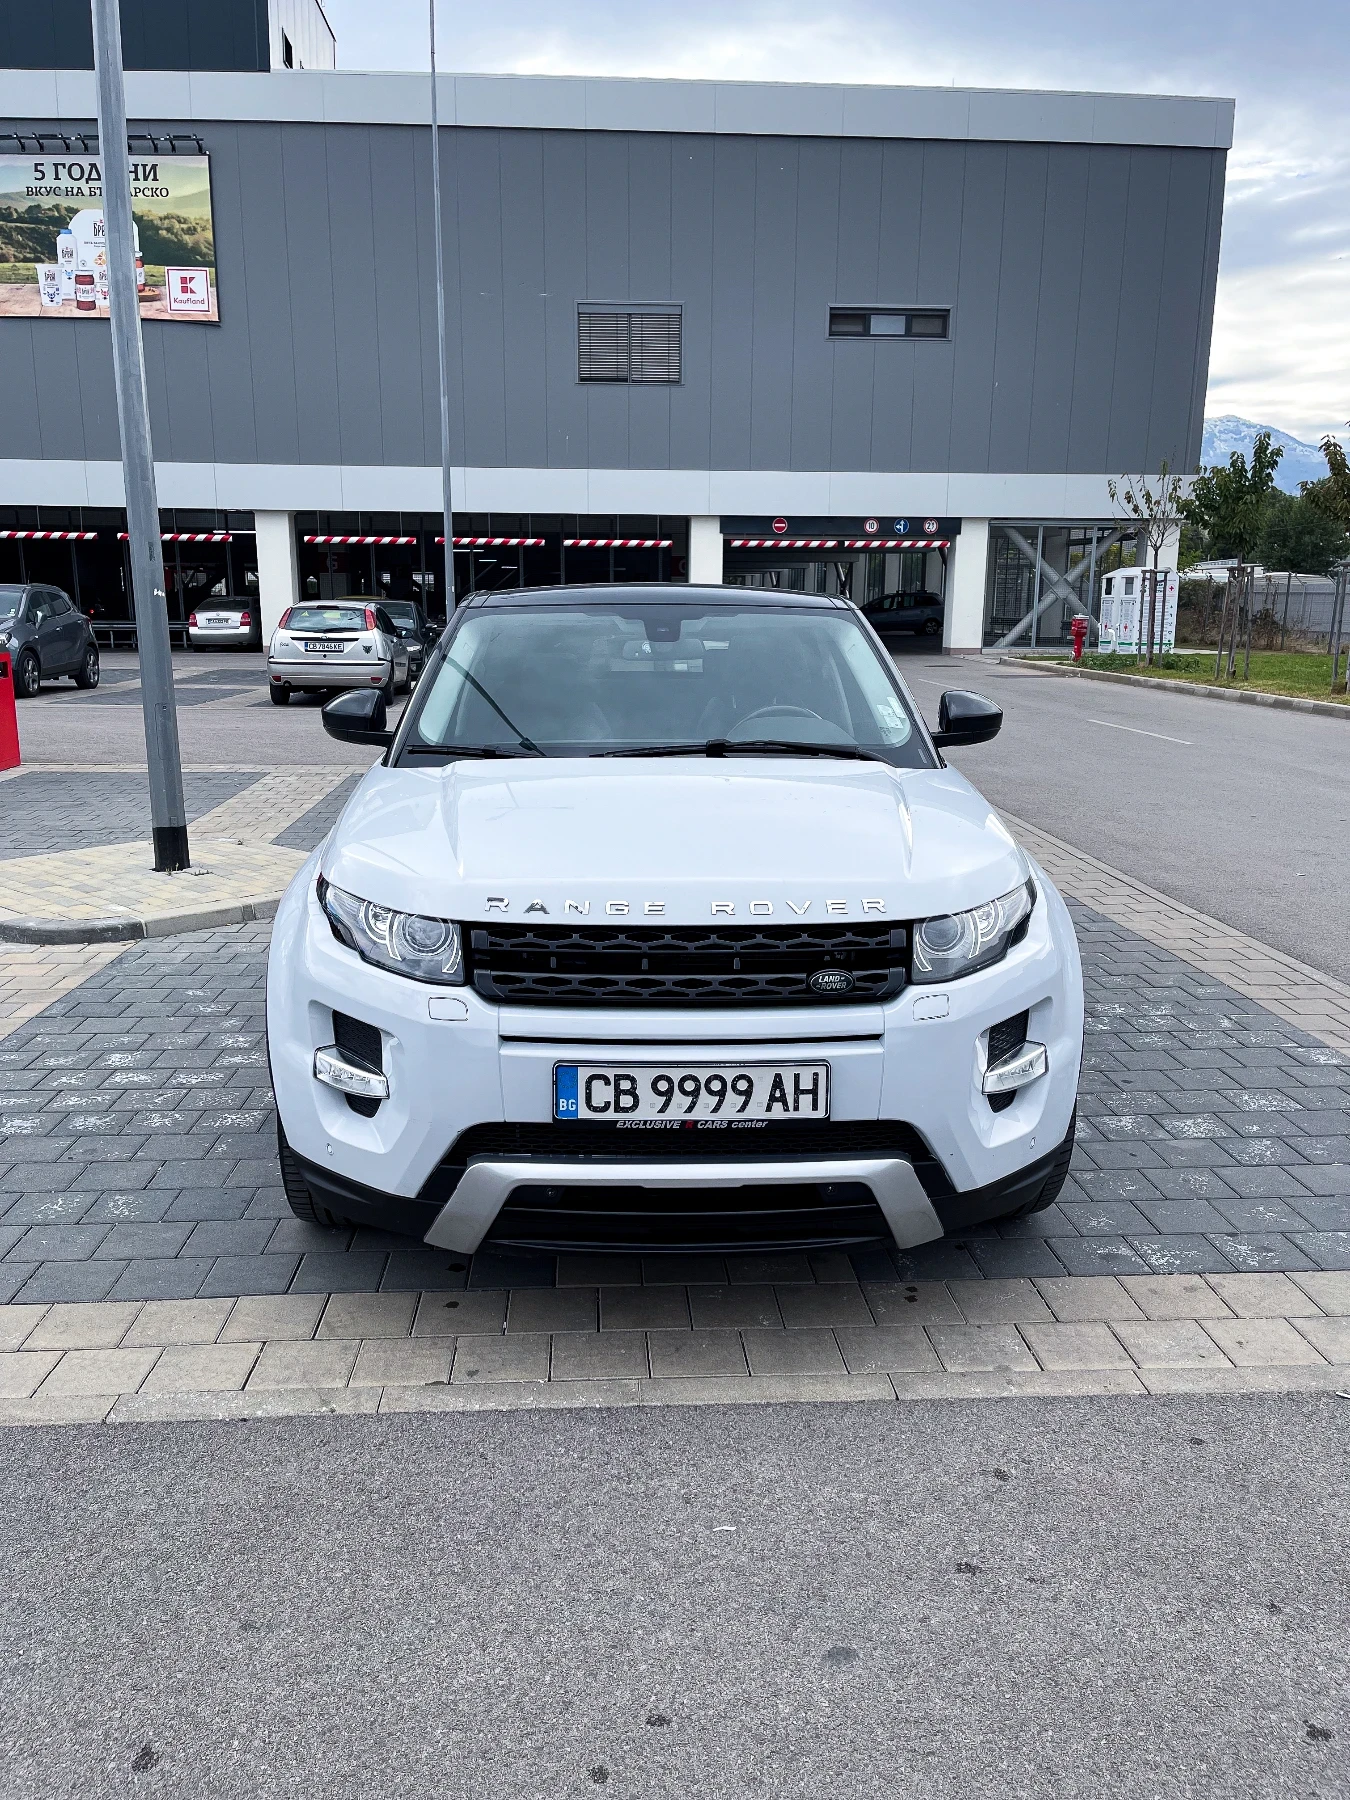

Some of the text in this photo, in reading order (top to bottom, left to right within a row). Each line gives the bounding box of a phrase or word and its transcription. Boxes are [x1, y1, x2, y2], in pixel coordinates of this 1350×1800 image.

[33, 162, 160, 184] 5 ГОДНИ
[25, 186, 170, 198] ВКУС НА БРСКО
[173, 297, 205, 305] Kaufland
[868, 522, 875, 530] 10
[485, 896, 887, 916] RANGE ROVER
[818, 975, 840, 983] LAND
[820, 981, 847, 990] ROVER
[584, 1071, 820, 1114] CB 9999 AH
[559, 1098, 576, 1111] BG
[616, 1120, 682, 1129] EXCLUSIVE
[697, 1120, 729, 1129] CARS
[731, 1120, 769, 1129] center
